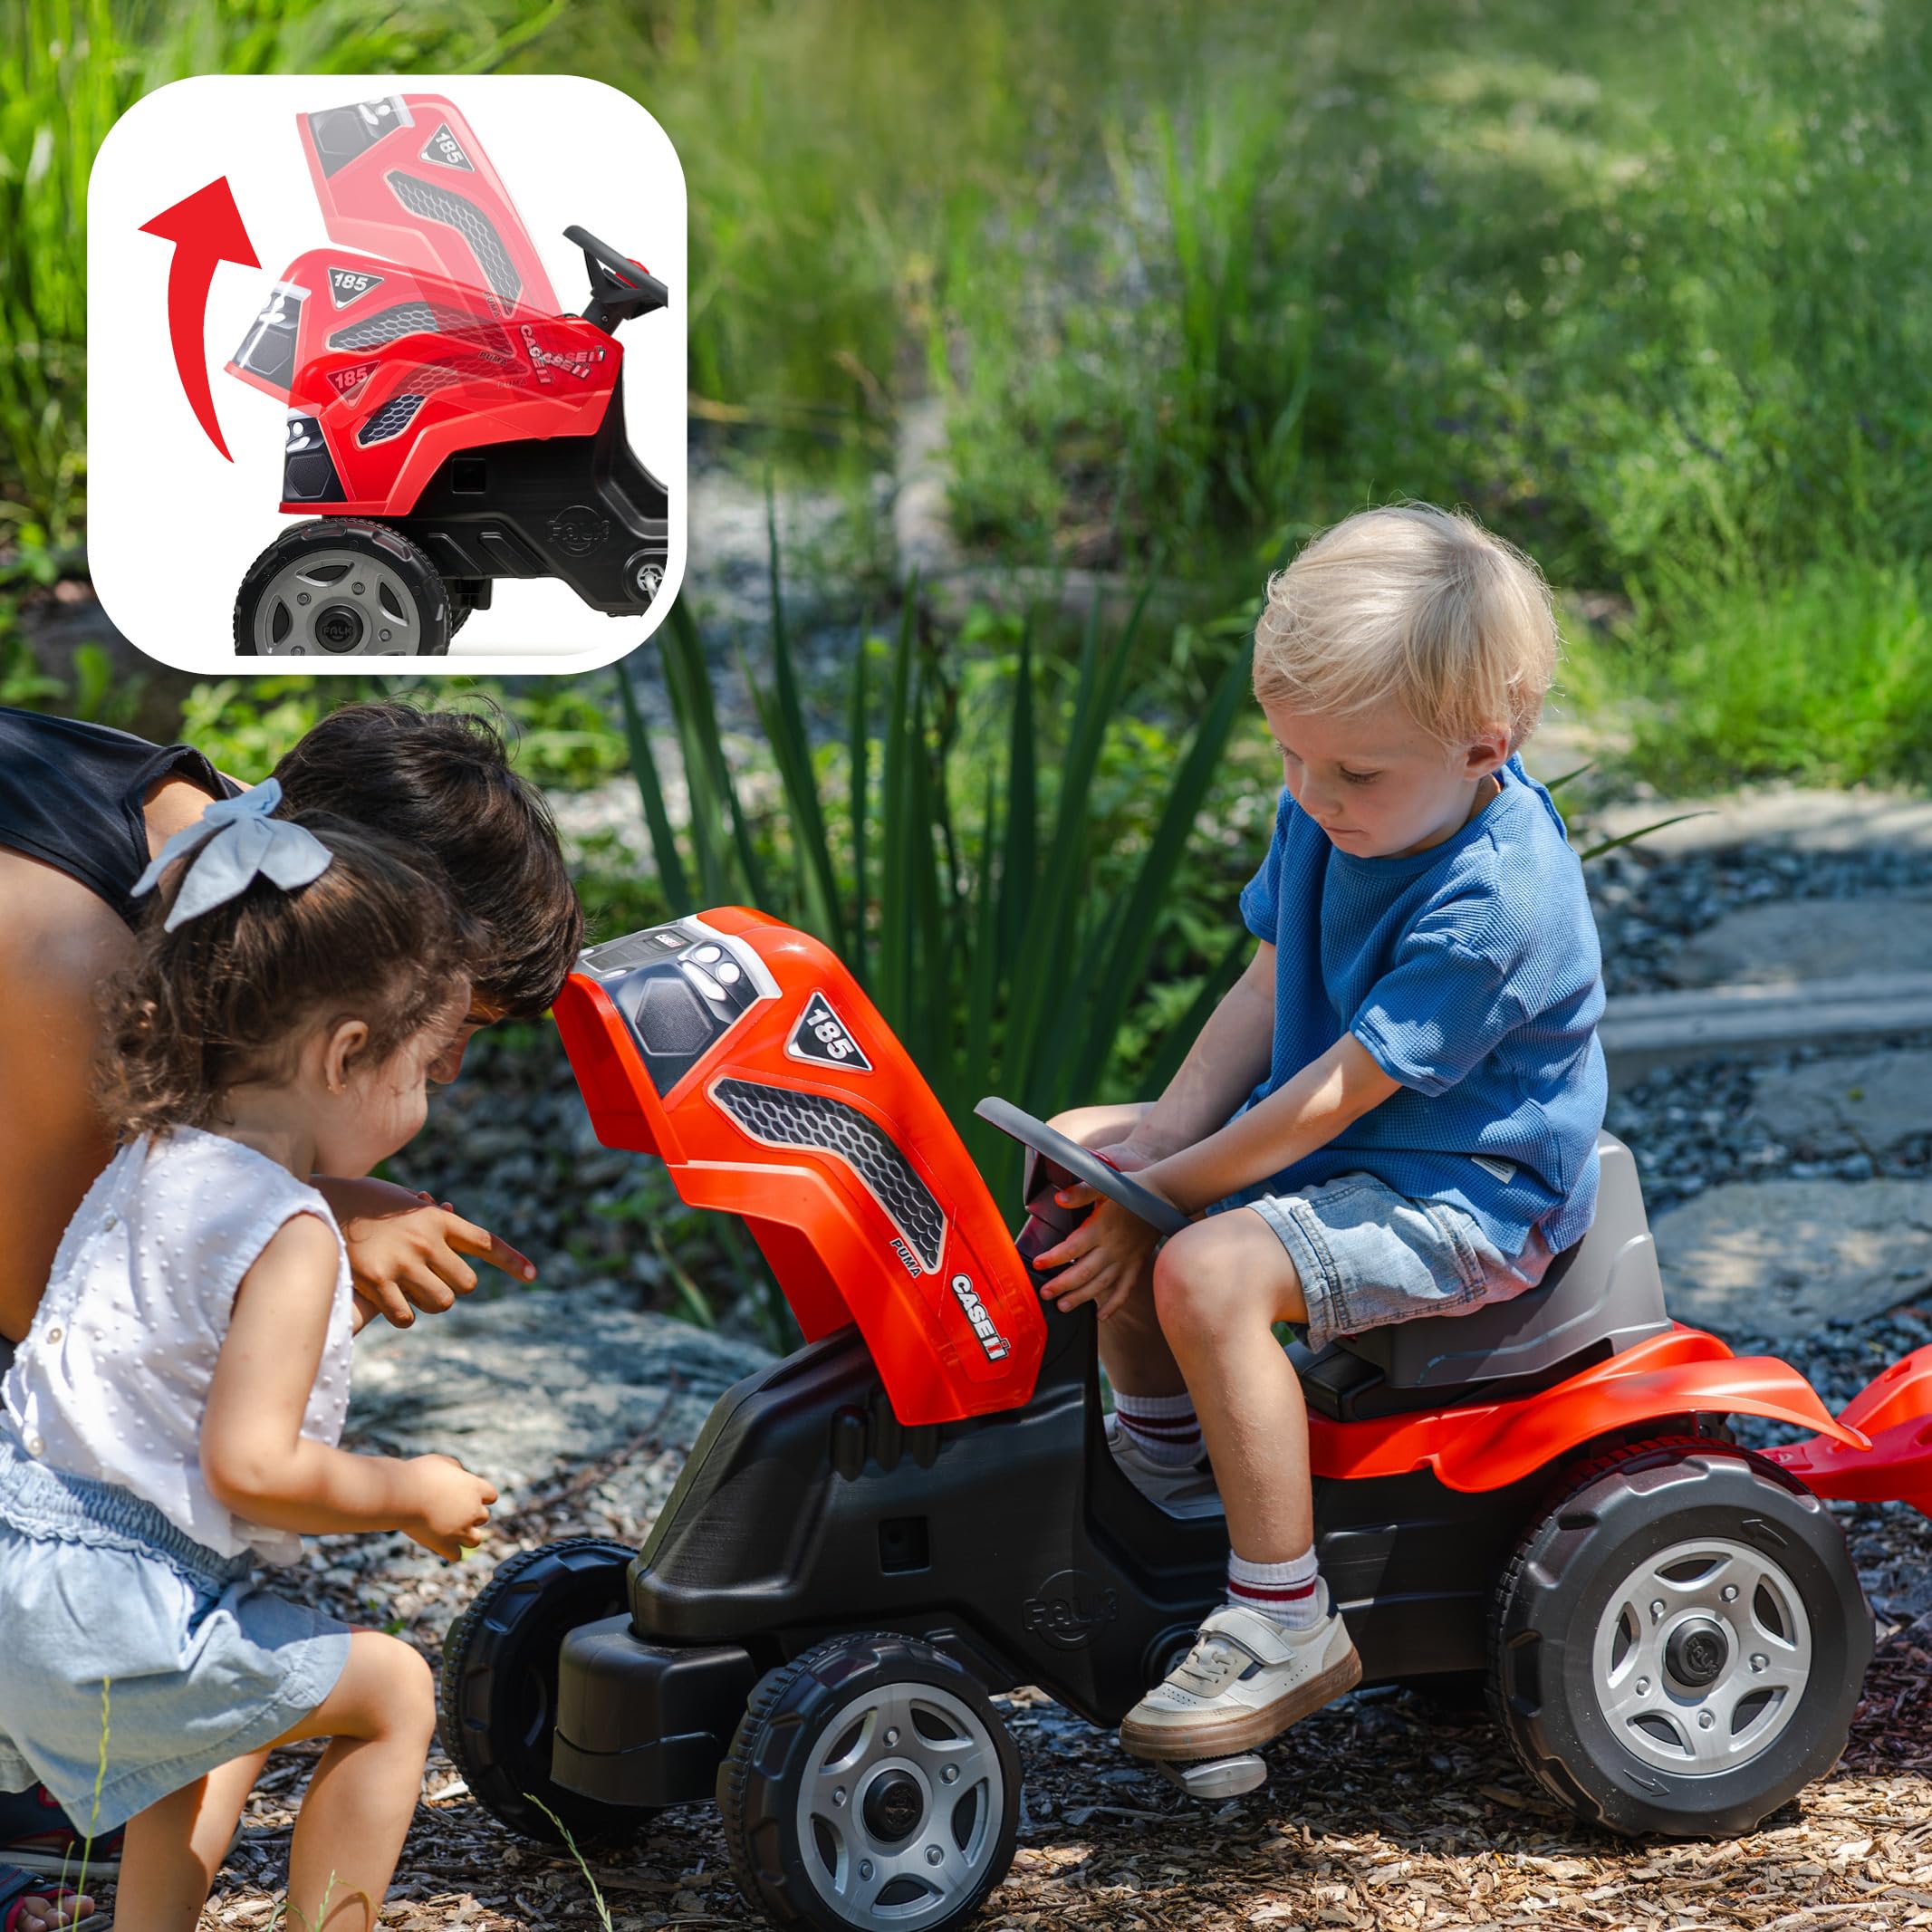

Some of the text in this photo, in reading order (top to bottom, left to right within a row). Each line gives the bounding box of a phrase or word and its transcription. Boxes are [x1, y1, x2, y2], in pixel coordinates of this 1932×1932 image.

[436, 132, 464, 163] 185
[334, 273, 369, 291] 185
[484, 291, 501, 318] PUMA
[479, 351, 507, 366] PUMA
[335, 367, 369, 389] 185
[322, 625, 354, 636] FALK
[806, 1008, 855, 1060] 185
[890, 1238, 922, 1278] PUMA
